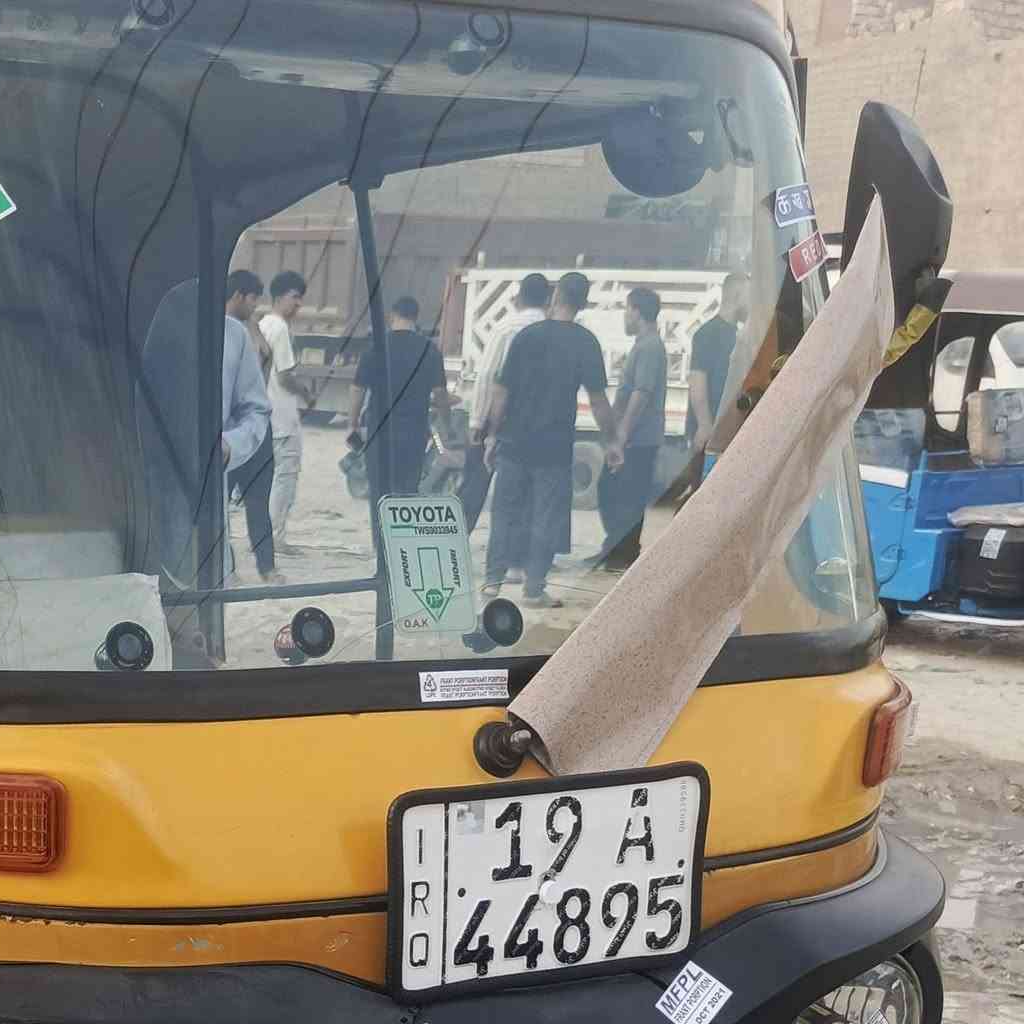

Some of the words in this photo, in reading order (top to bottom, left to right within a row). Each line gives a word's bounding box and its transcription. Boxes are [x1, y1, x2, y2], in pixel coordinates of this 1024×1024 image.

[388, 506, 457, 523] TOYOTA
[400, 548, 412, 588] EXPORT
[491, 795, 583, 882] 19
[616, 787, 655, 865] A
[453, 874, 685, 977] 44895
[660, 968, 705, 1016] MFPL
[695, 1007, 711, 1024] OCT
[708, 988, 726, 1008] 2021
